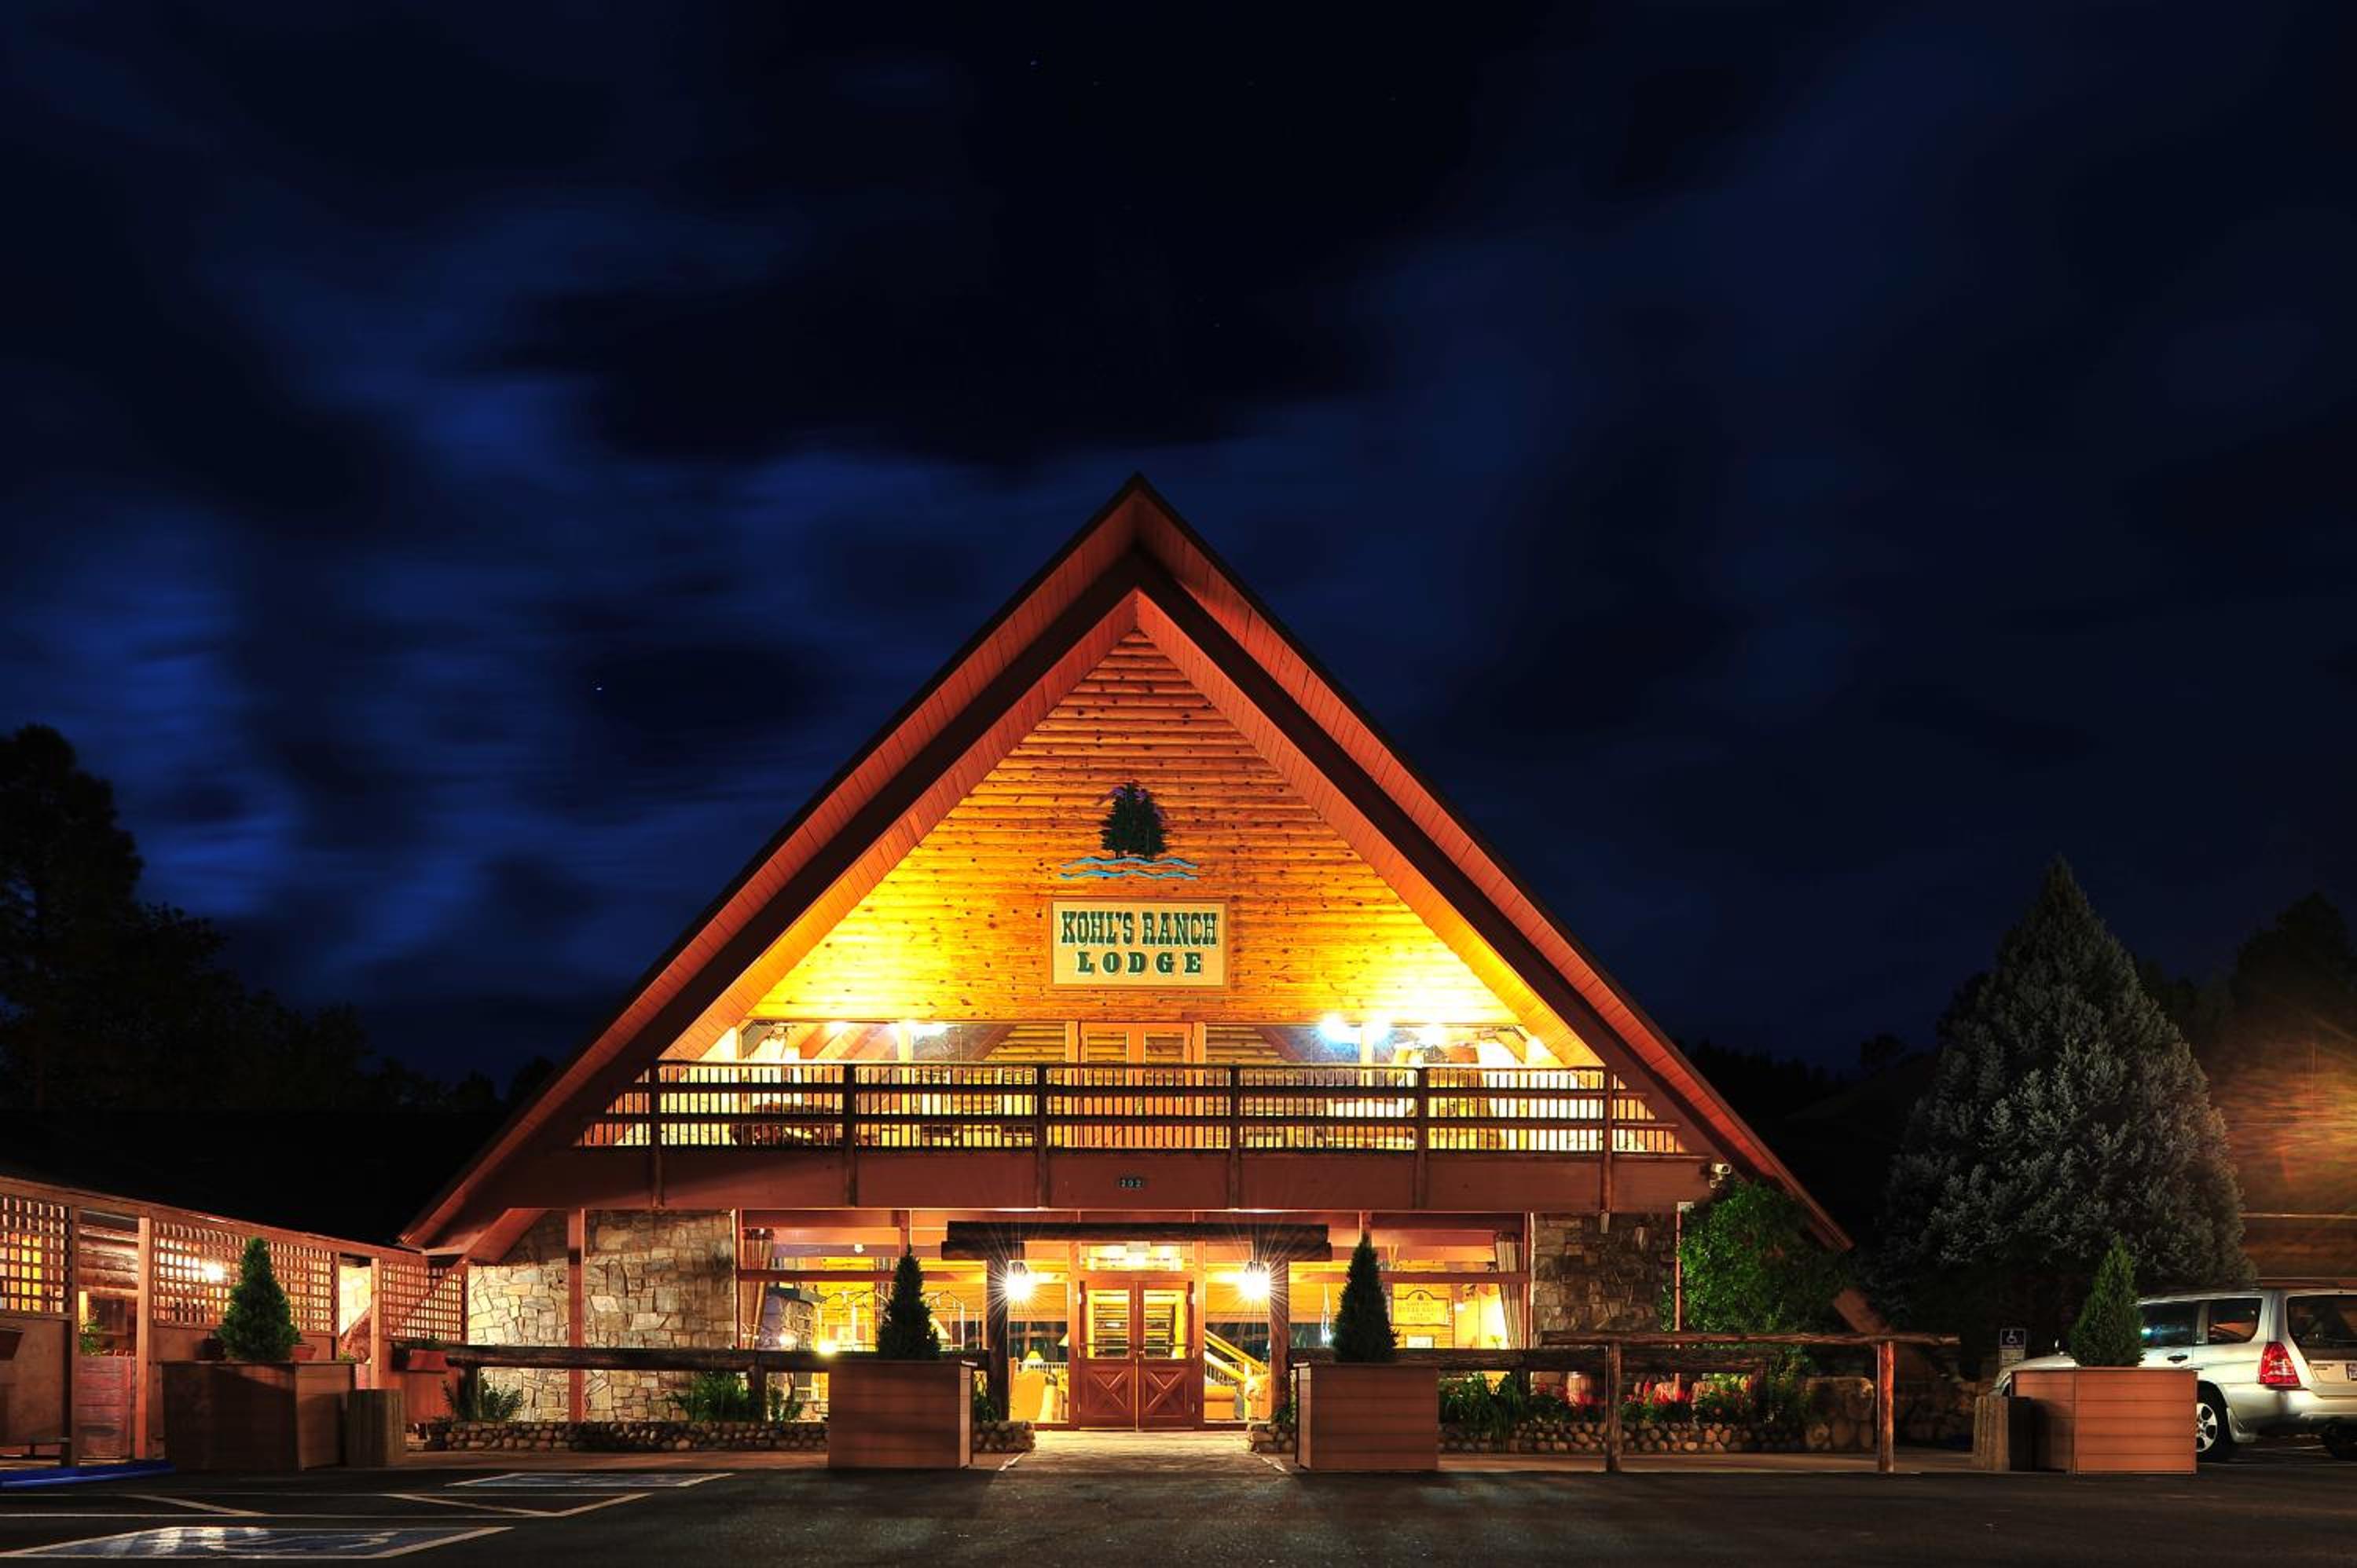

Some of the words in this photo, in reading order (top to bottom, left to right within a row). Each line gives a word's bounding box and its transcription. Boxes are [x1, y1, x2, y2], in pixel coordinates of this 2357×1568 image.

[1061, 910, 1135, 944] KOHL'S
[1142, 911, 1217, 945] RANCH
[1076, 951, 1202, 974] LODGE
